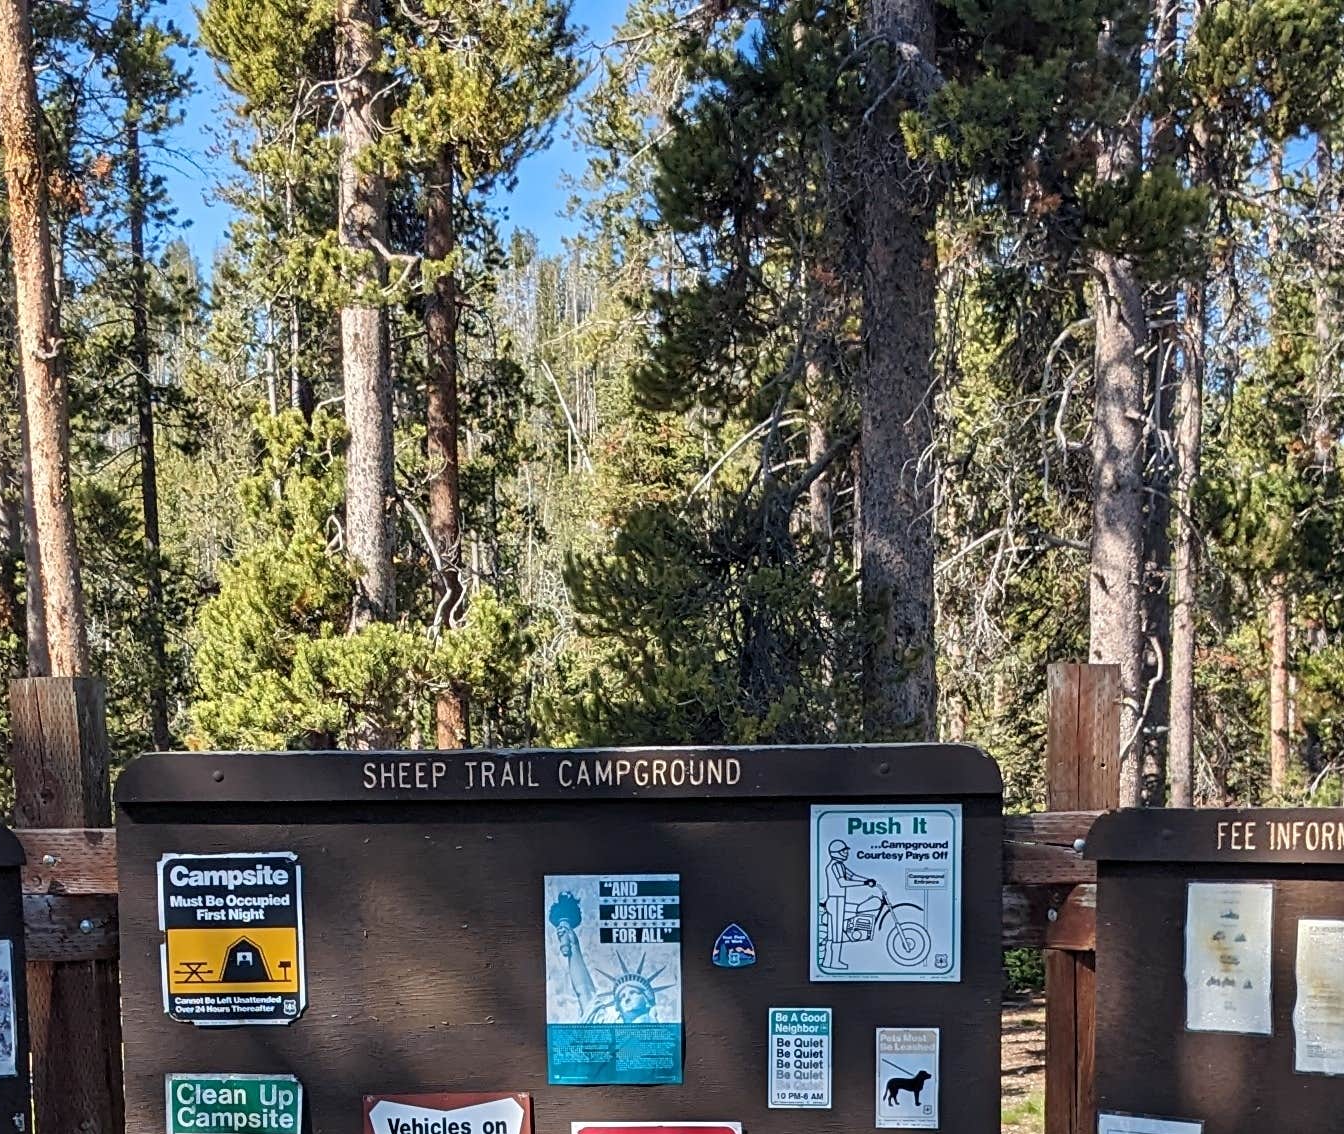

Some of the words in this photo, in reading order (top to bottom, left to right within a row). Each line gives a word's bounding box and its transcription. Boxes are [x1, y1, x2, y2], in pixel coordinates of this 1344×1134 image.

[363, 761, 447, 789] SHEEP
[464, 760, 540, 789] TRAIL
[558, 758, 742, 788] CAMPGROUND
[847, 816, 901, 836] Push
[913, 816, 927, 835] It
[1217, 821, 1256, 850] FEE
[870, 840, 949, 851] ...Campground
[856, 851, 903, 862] Courtesy
[905, 851, 931, 862] Pays
[932, 850, 949, 860] Off
[169, 864, 289, 890] Campsite
[169, 895, 203, 907] Must
[205, 895, 224, 907] Be
[225, 894, 290, 908] Occupied
[196, 909, 226, 921] First
[228, 908, 265, 922] Night
[611, 904, 664, 920] JUSTICE
[612, 928, 637, 943] FOR
[174, 997, 204, 1005] Cannot
[205, 997, 215, 1005] Be
[216, 996, 233, 1005] Left
[233, 995, 282, 1004] Unattended
[175, 1005, 195, 1014] Over
[195, 1005, 205, 1013] 24
[206, 1005, 230, 1013] Hours
[231, 1005, 276, 1013] Thereafter
[775, 1013, 788, 1022] Be
[790, 1013, 798, 1022] A
[800, 1012, 827, 1022] Good
[775, 1023, 819, 1034] Neighbor
[777, 1037, 791, 1048] Be
[794, 1037, 824, 1048] Quiet
[777, 1048, 791, 1058] Be
[794, 1048, 824, 1058] Quiet
[777, 1059, 791, 1069] Be
[794, 1059, 824, 1069] Quiet
[777, 1070, 791, 1080] Be
[794, 1070, 824, 1080] Quiet
[176, 1082, 247, 1106] Clean
[259, 1083, 294, 1110] Up
[777, 1092, 786, 1100] 10
[811, 1092, 824, 1100] AM
[176, 1106, 294, 1131] Campsite
